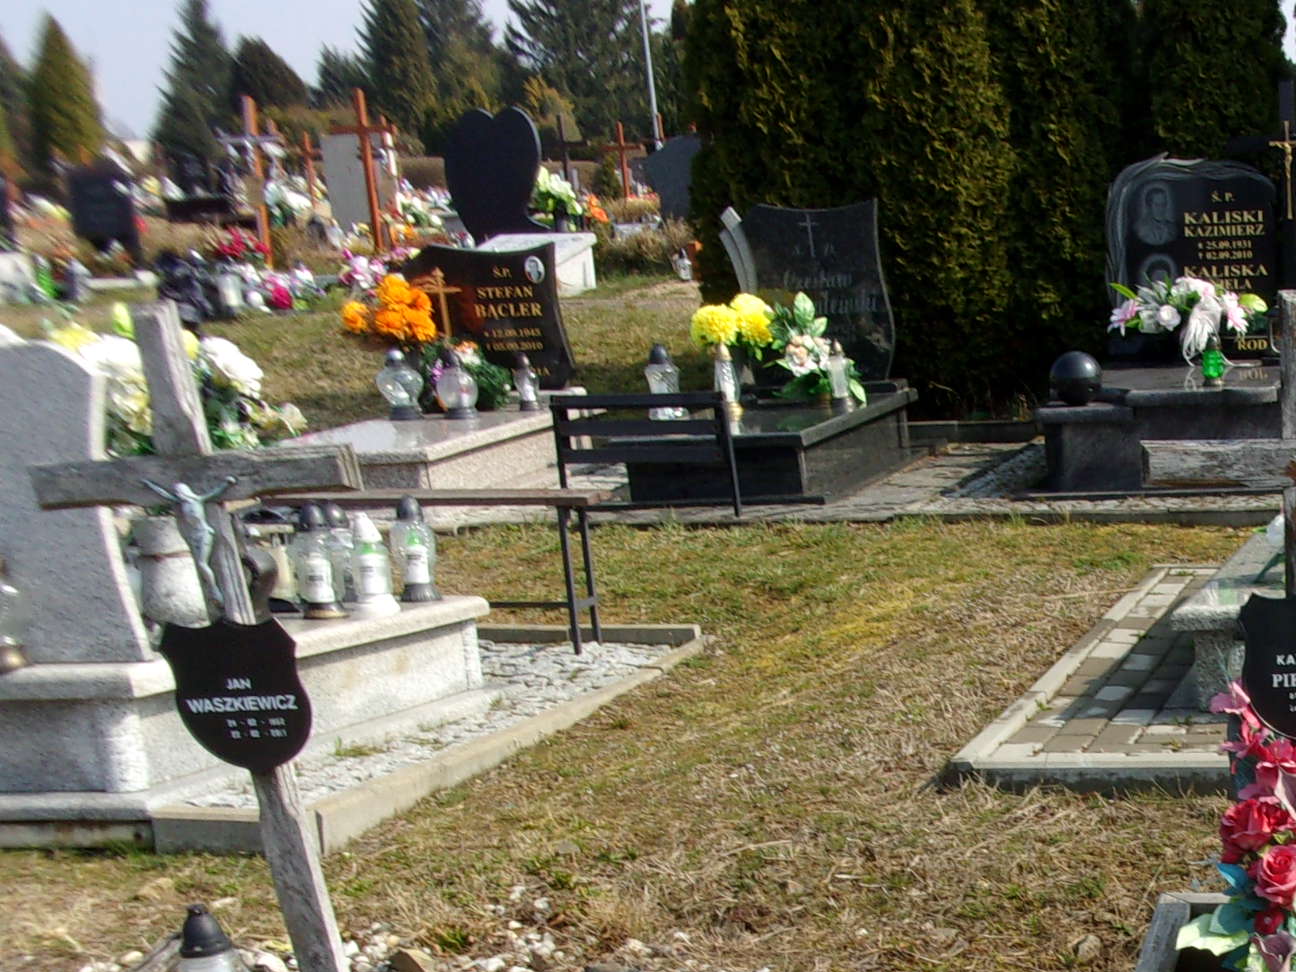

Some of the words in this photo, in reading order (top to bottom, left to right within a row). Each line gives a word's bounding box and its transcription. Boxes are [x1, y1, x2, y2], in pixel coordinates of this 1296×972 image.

[1184, 210, 1264, 224] KALISKI
[1184, 224, 1265, 237] KAZIMIERZ
[1184, 264, 1268, 278] KALISKA
[476, 286, 534, 299] STEFAN
[225, 678, 252, 690] JAN
[185, 694, 299, 714] WASZKIEWICZ
